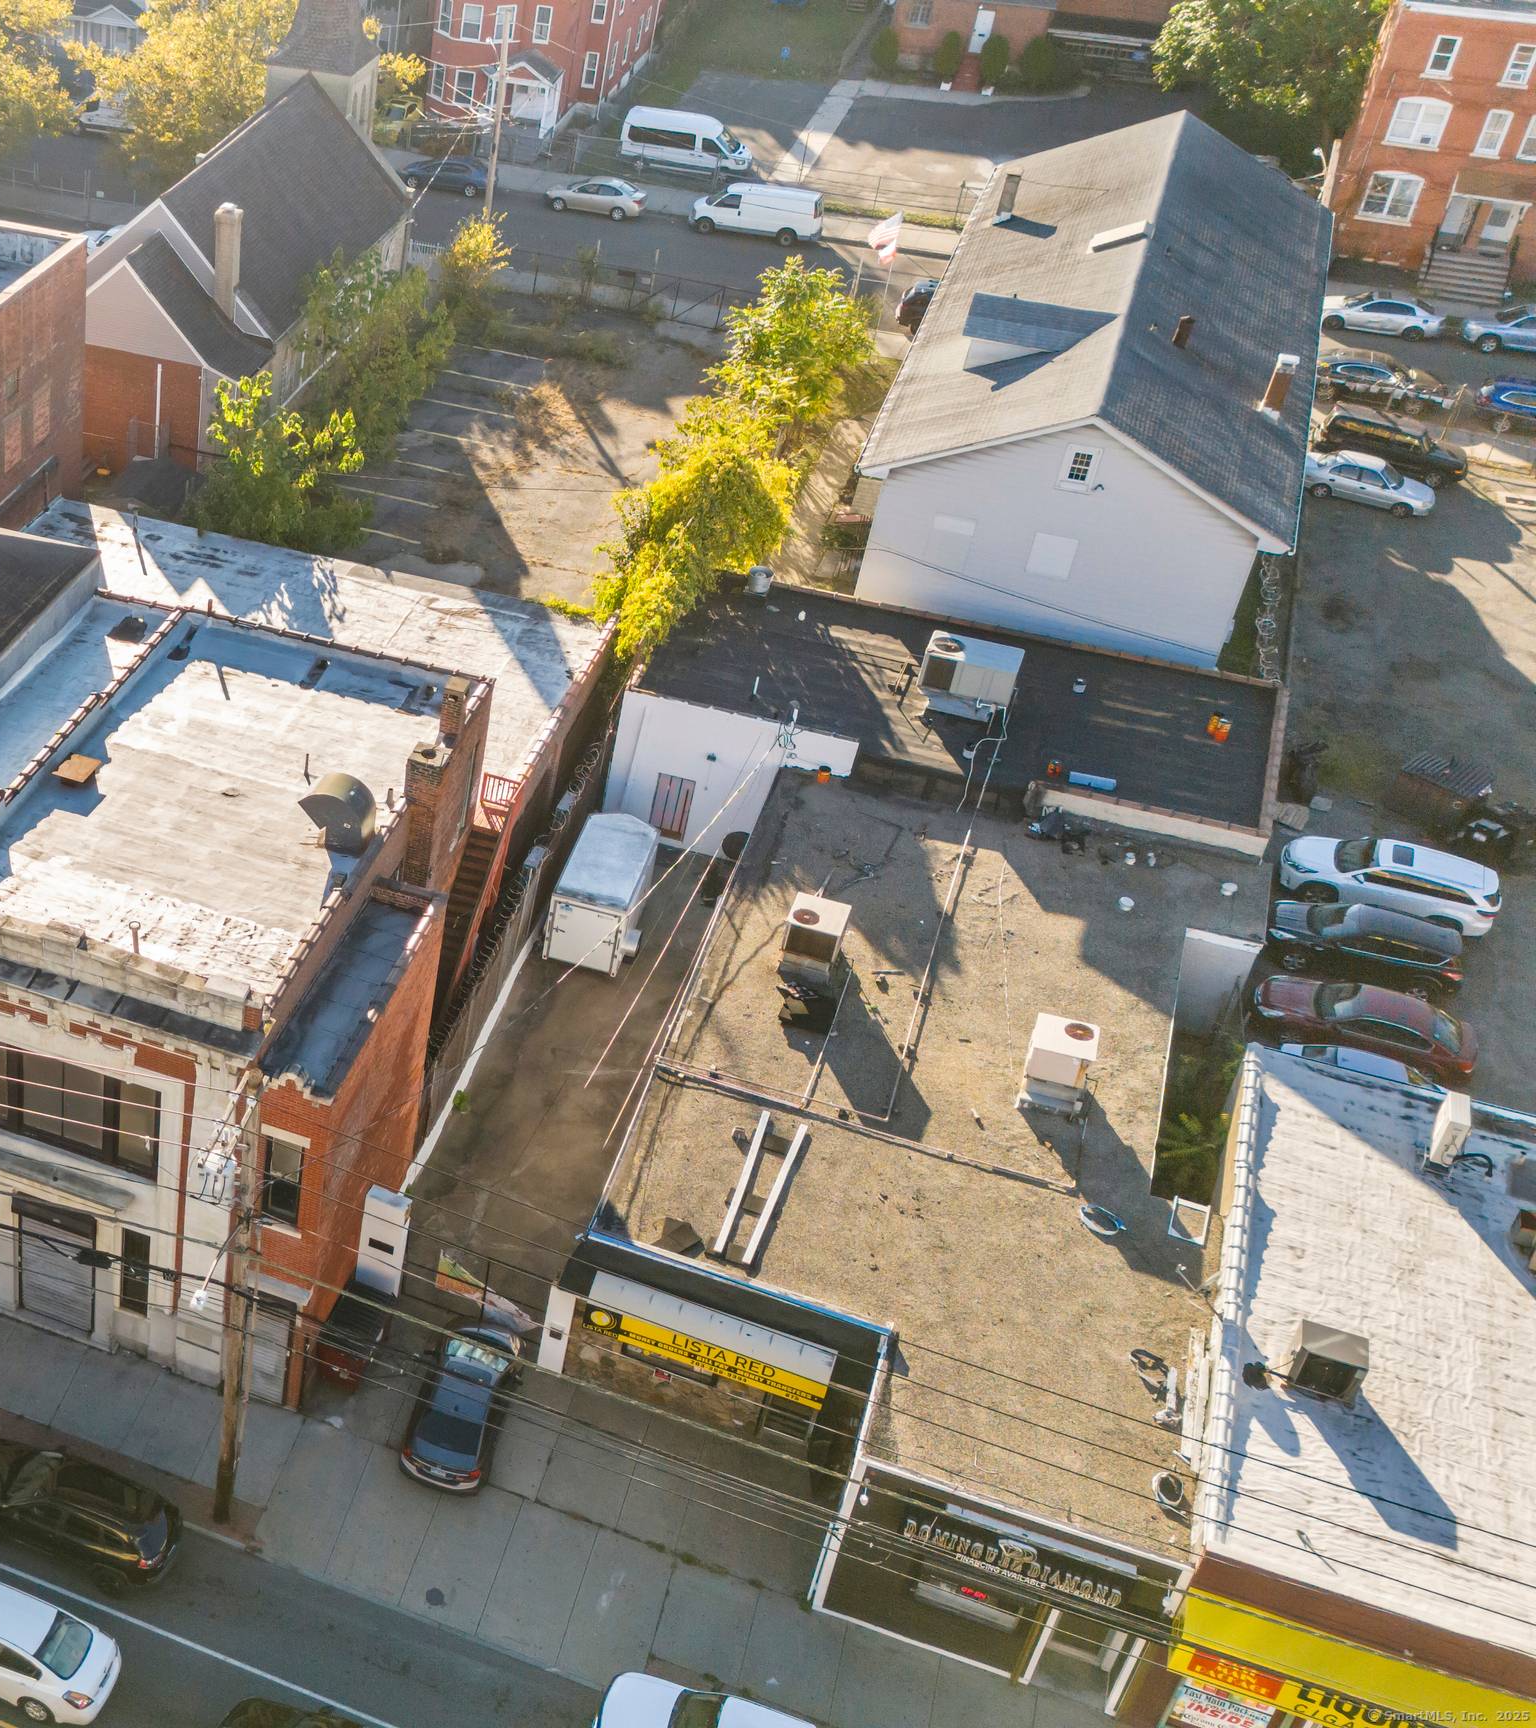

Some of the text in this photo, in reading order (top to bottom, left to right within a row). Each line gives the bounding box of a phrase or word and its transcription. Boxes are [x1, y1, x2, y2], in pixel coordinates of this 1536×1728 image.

[582, 1323, 618, 1338] LISTA RED
[629, 1332, 813, 1400] MONEY ORDERS BILL PAY MONEY TRANSFERS
[672, 1333, 776, 1378] LISTA RED
[956, 1552, 1000, 1574] FINANCING
[1001, 1569, 1047, 1590] AVAILABLE
[1027, 1561, 1122, 1606] DIAMOND
[961, 1586, 987, 1599] OPEN
[1184, 1688, 1202, 1700] East
[1205, 1695, 1226, 1707] Main
[1187, 1702, 1255, 1728] INSIDE
